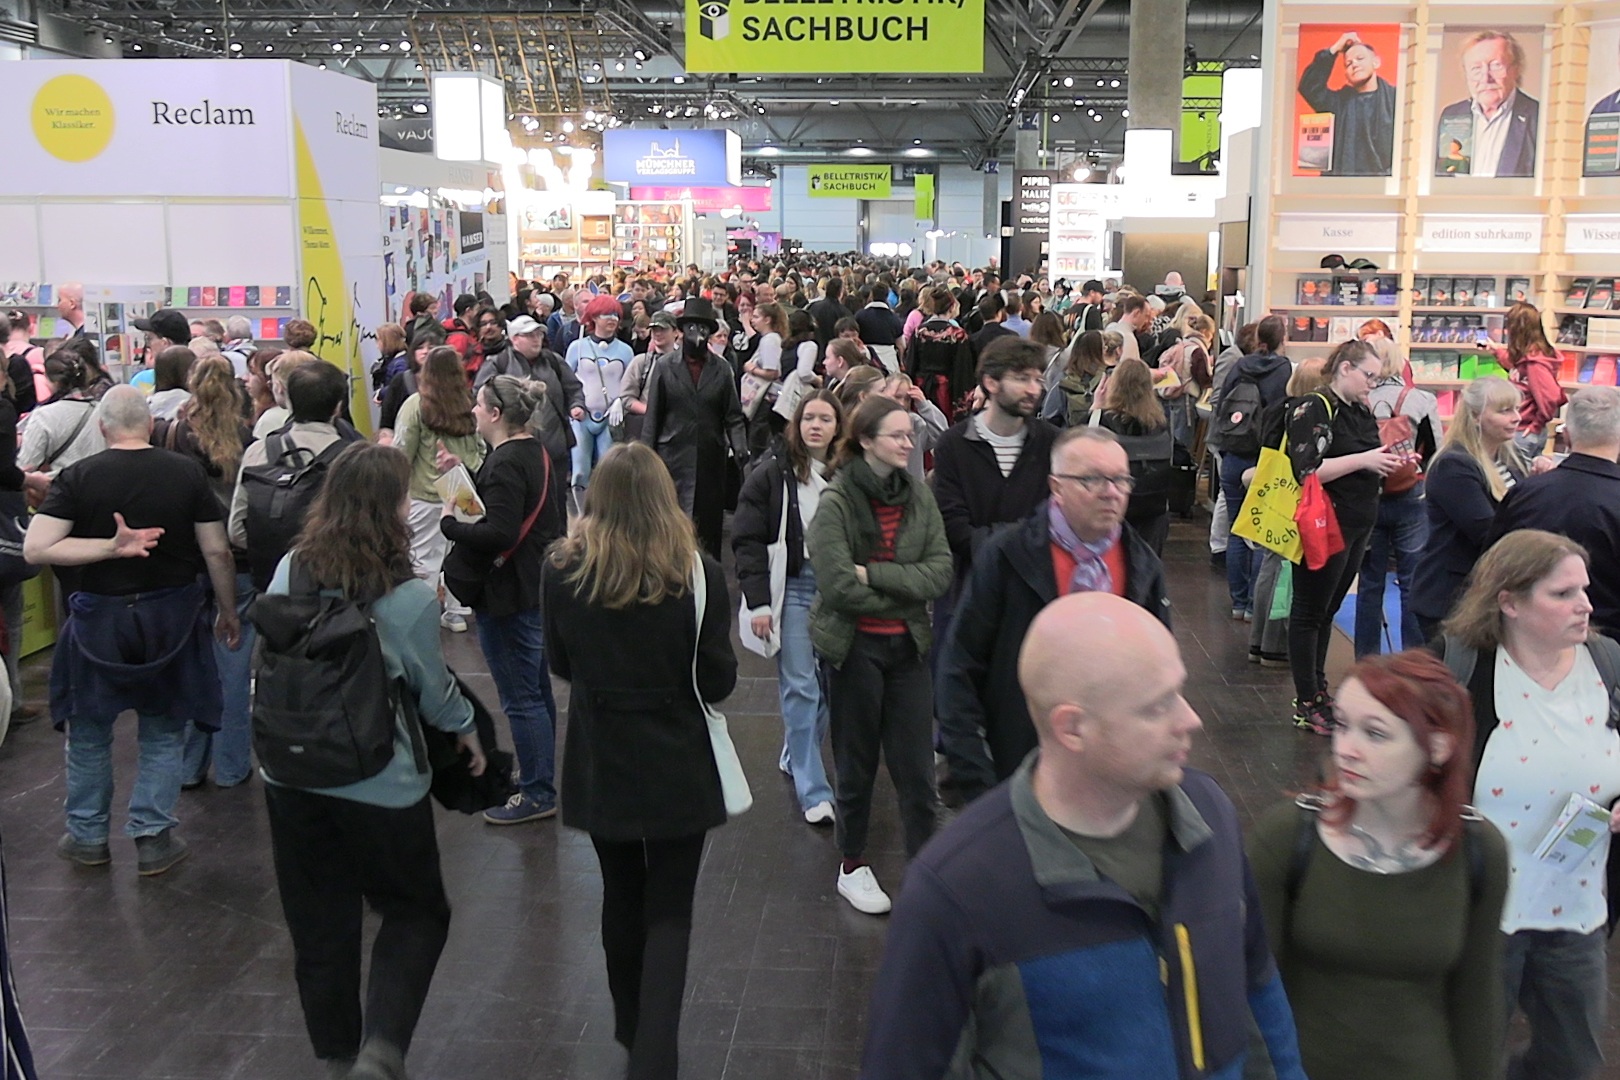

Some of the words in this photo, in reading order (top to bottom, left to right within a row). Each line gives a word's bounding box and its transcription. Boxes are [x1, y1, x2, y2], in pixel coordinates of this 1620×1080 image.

[742, 16, 929, 41] SACHBUCH
[45, 107, 64, 116] Wir
[65, 107, 101, 116] machen
[151, 99, 256, 125] Reclam
[336, 111, 368, 139] Reclam
[635, 158, 696, 169] MÜNCHNER
[824, 172, 888, 181] BELLETRISTIK/
[1021, 176, 1051, 187] PIPER
[824, 183, 876, 191] SACHBUCH
[1021, 189, 1050, 199] MALIK
[1322, 226, 1354, 238] Kasse
[1432, 228, 1471, 240] edition
[1474, 228, 1533, 242] suhrkamp
[462, 232, 482, 248] HANSER
[1257, 482, 1271, 498] es
[1265, 527, 1298, 546] Buch
